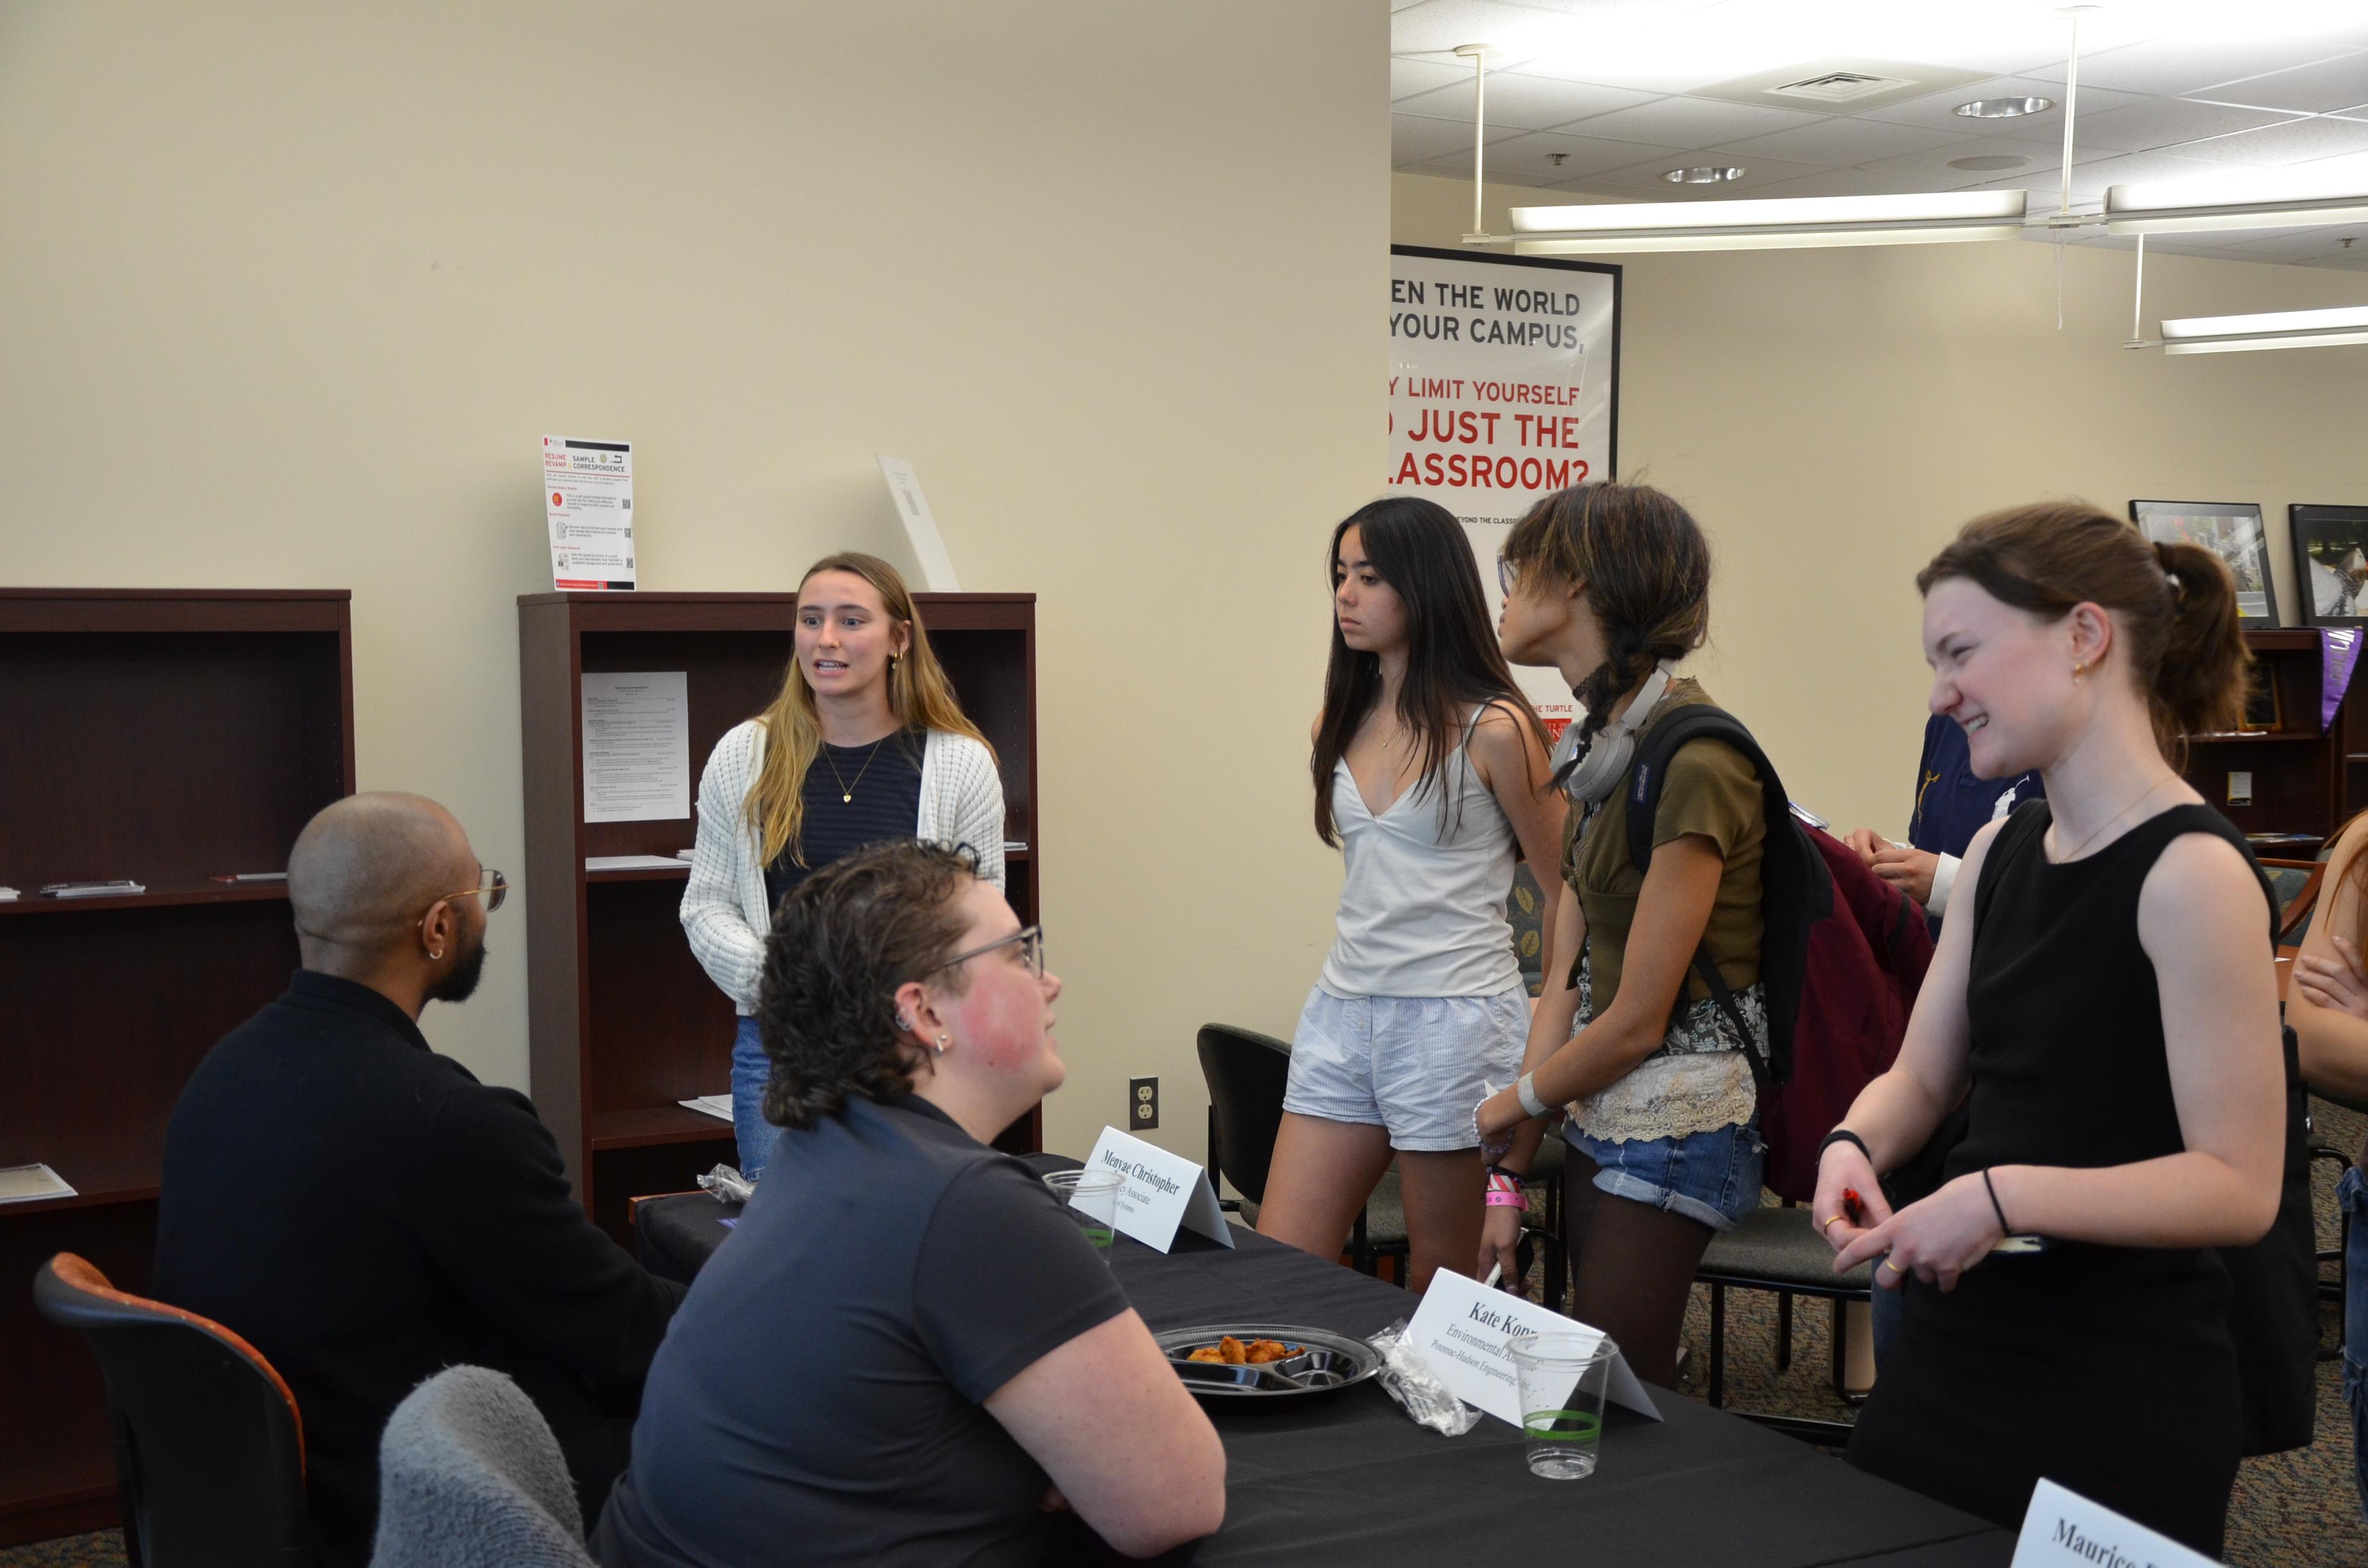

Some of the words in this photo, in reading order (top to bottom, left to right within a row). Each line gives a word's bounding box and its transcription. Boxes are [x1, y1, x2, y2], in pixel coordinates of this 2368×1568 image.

[1435, 282, 1484, 309] THE
[1494, 288, 1580, 316] WORLD
[1390, 313, 1459, 341] YOUR
[1470, 318, 1584, 354] CAMPUS,
[1408, 377, 1464, 399] LIMIT
[1472, 381, 1579, 405] YOURSELF
[1408, 409, 1501, 445] JUST
[1514, 414, 1579, 449] THE
[573, 462, 625, 473] CORRESPONDENCE
[1389, 452, 1589, 491] ASSROOM?
[1101, 1149, 1132, 1173] Menyae
[1131, 1163, 1180, 1196] Christopher
[1468, 1302, 1501, 1328] Kate
[1430, 1339, 1481, 1369] Potomac-Hudson
[1445, 1323, 1506, 1358] Environmental
